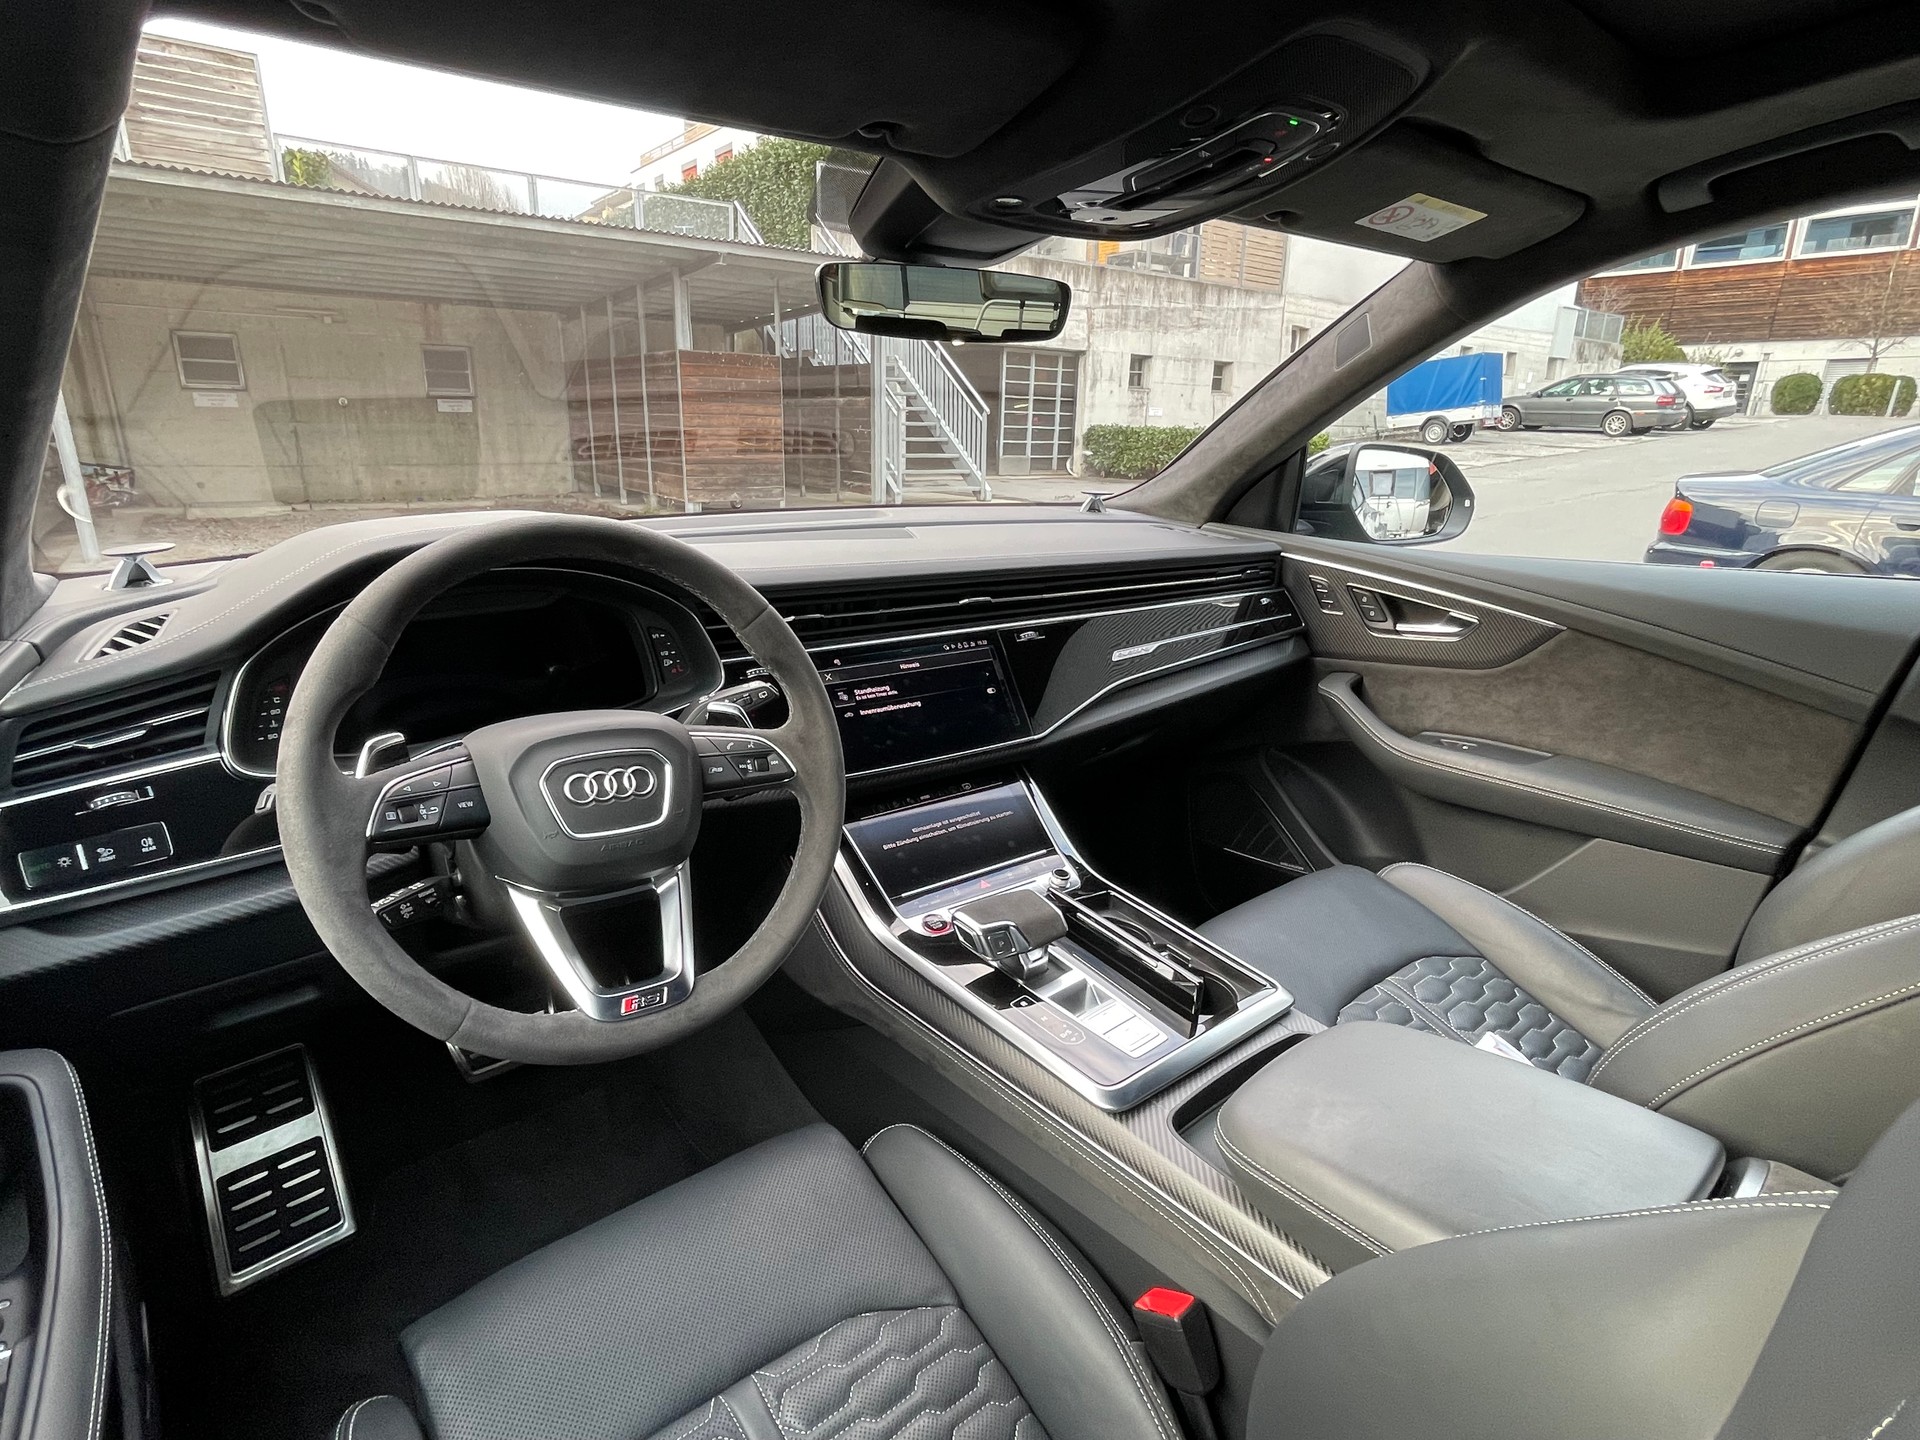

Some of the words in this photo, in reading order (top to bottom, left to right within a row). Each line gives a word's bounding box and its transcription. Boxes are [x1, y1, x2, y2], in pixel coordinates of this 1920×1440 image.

[899, 661, 920, 670] Hinweis
[854, 684, 890, 696] Standheizung
[859, 700, 922, 716] Innenraumüberwachung
[457, 800, 474, 809] VIEW
[141, 845, 157, 853] REAR
[882, 841, 896, 851] Bitte
[98, 854, 117, 863] FRONT
